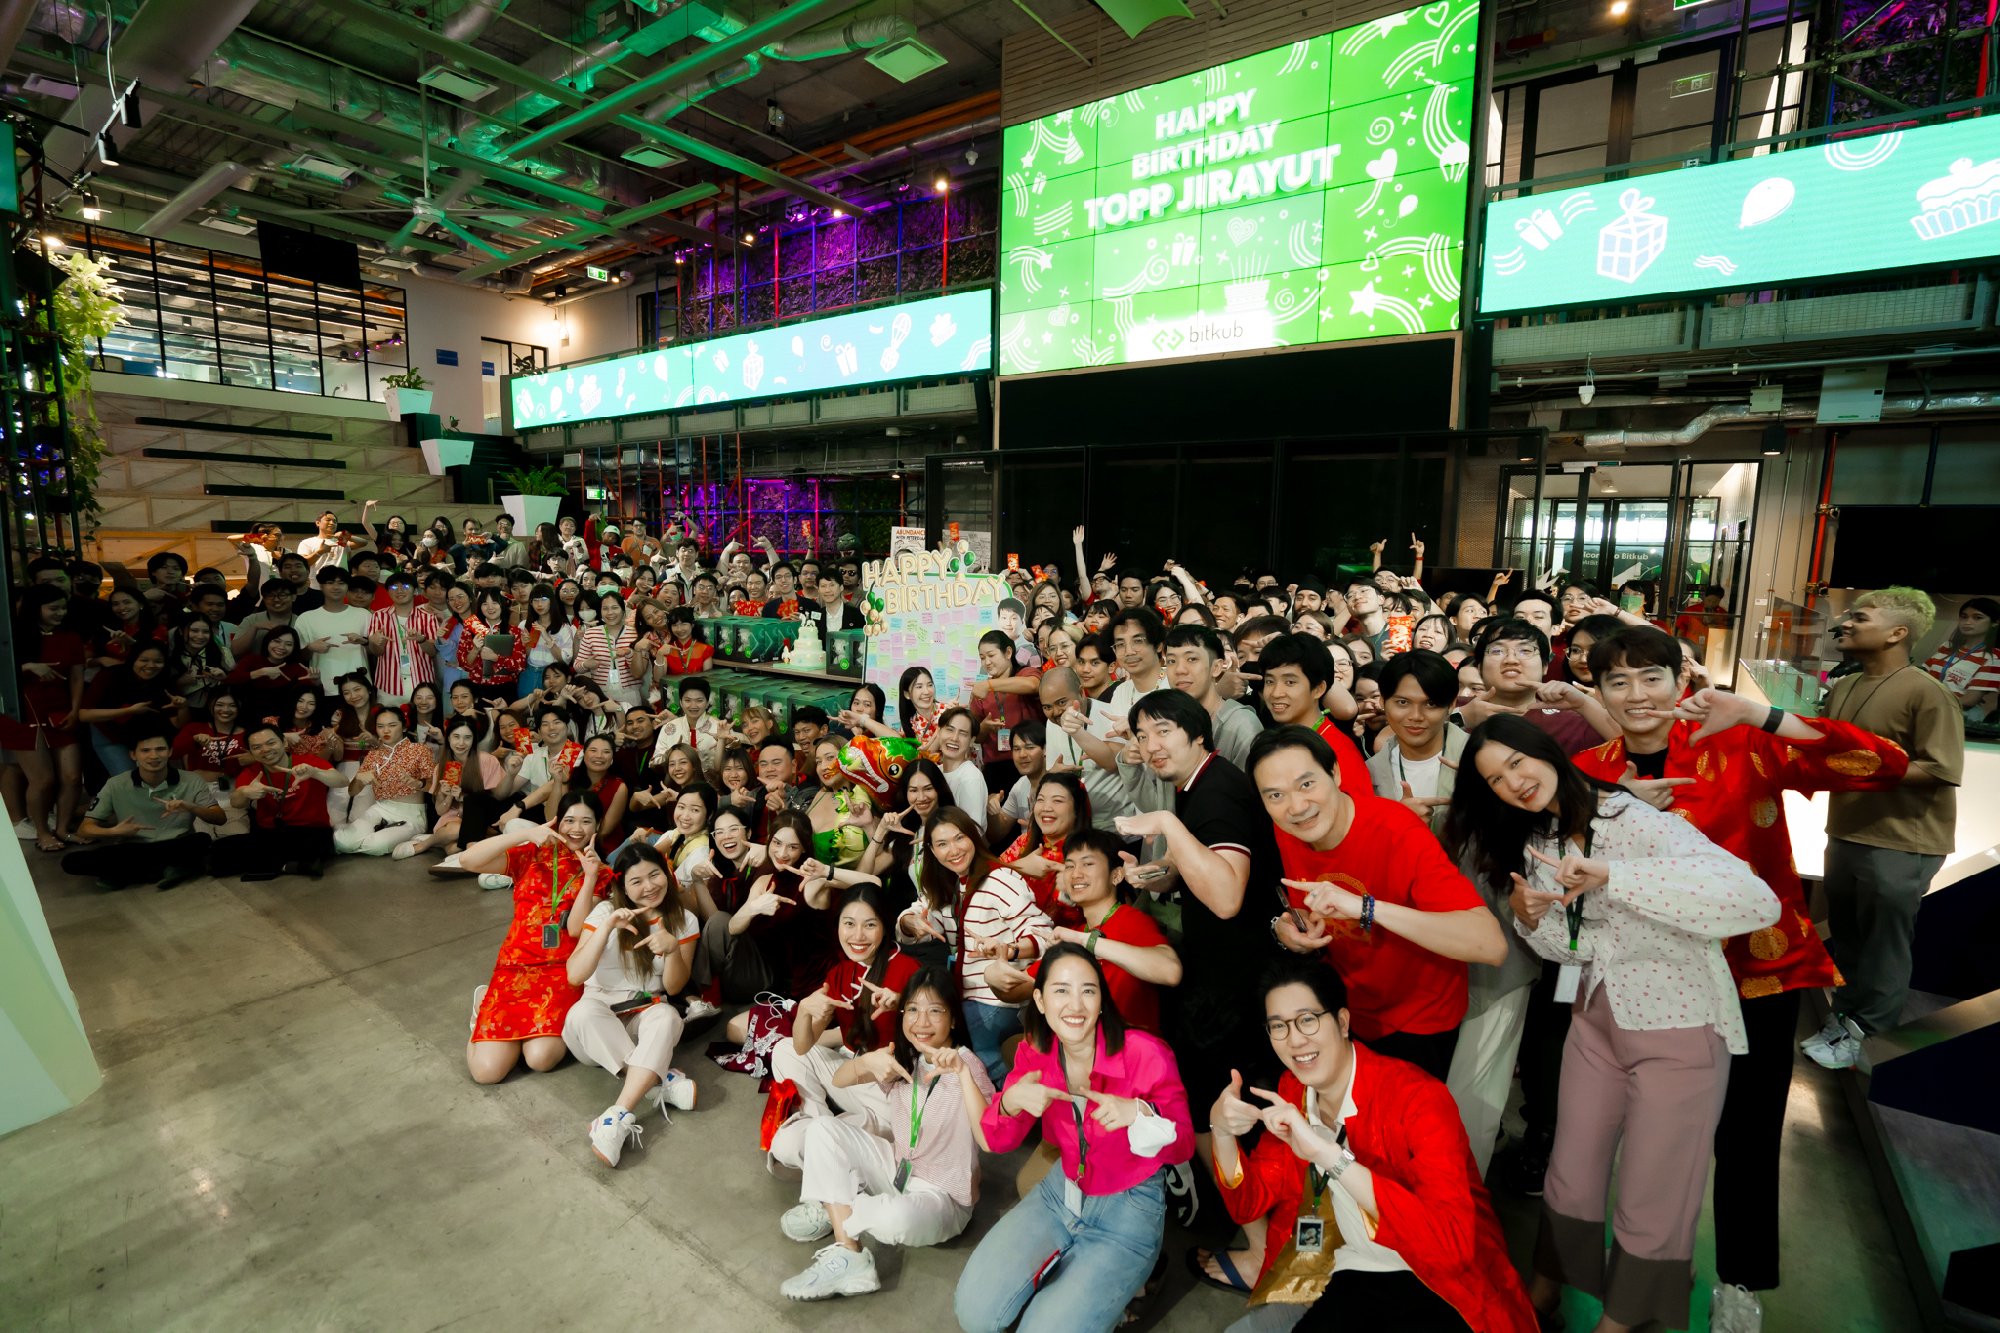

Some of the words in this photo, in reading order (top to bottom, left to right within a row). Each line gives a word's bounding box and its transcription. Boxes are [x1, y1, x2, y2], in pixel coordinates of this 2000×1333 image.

[1156, 88, 1257, 140] HAPPY
[1132, 119, 1282, 180] BIRTHDAY
[1084, 183, 1175, 229] TOPP
[1177, 144, 1341, 212] JIRAYUT
[1189, 320, 1243, 342] bitkub
[863, 549, 952, 589] HAPPY
[1621, 552, 1649, 560] Bitkub
[885, 575, 1005, 614] BIRTHDAY
